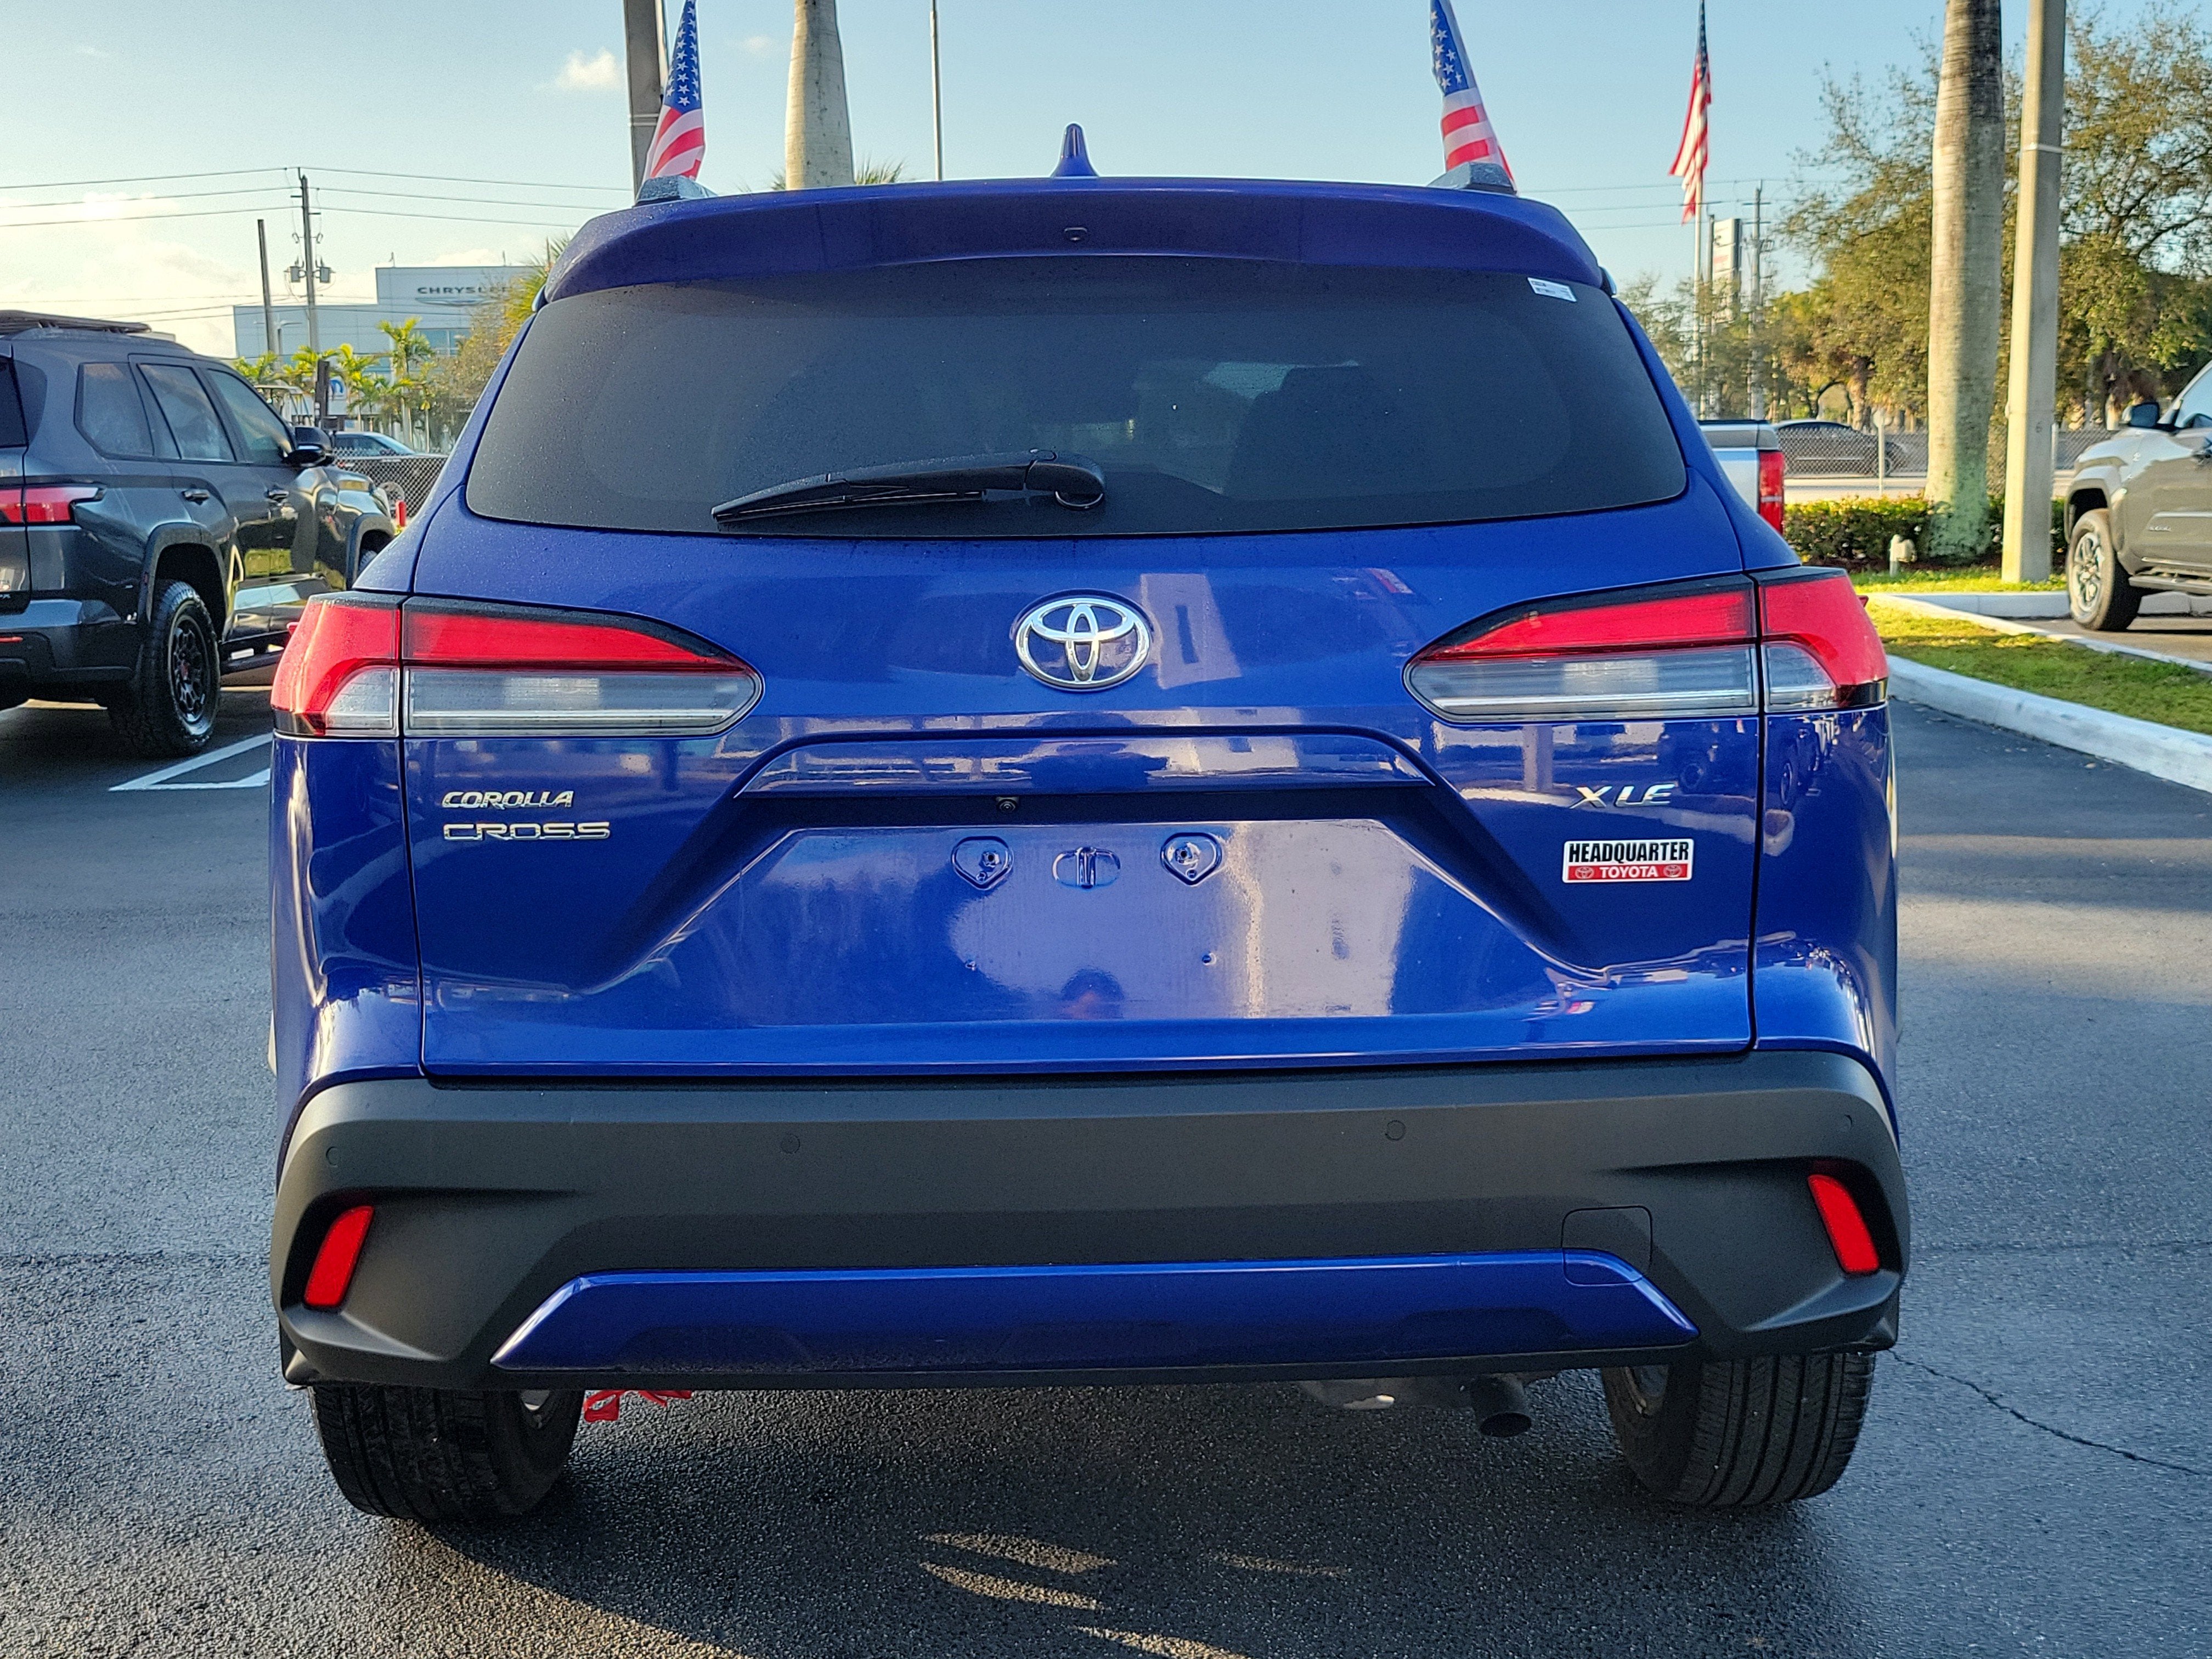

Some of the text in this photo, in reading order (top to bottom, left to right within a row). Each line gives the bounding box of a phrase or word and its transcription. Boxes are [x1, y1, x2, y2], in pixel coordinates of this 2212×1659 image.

[441, 790, 574, 809] COROLLA
[1568, 783, 1675, 809] XLE
[443, 822, 610, 840] CROSS
[1568, 842, 1689, 864] HEADQUARTER
[1599, 865, 1658, 878] TOYOTA
